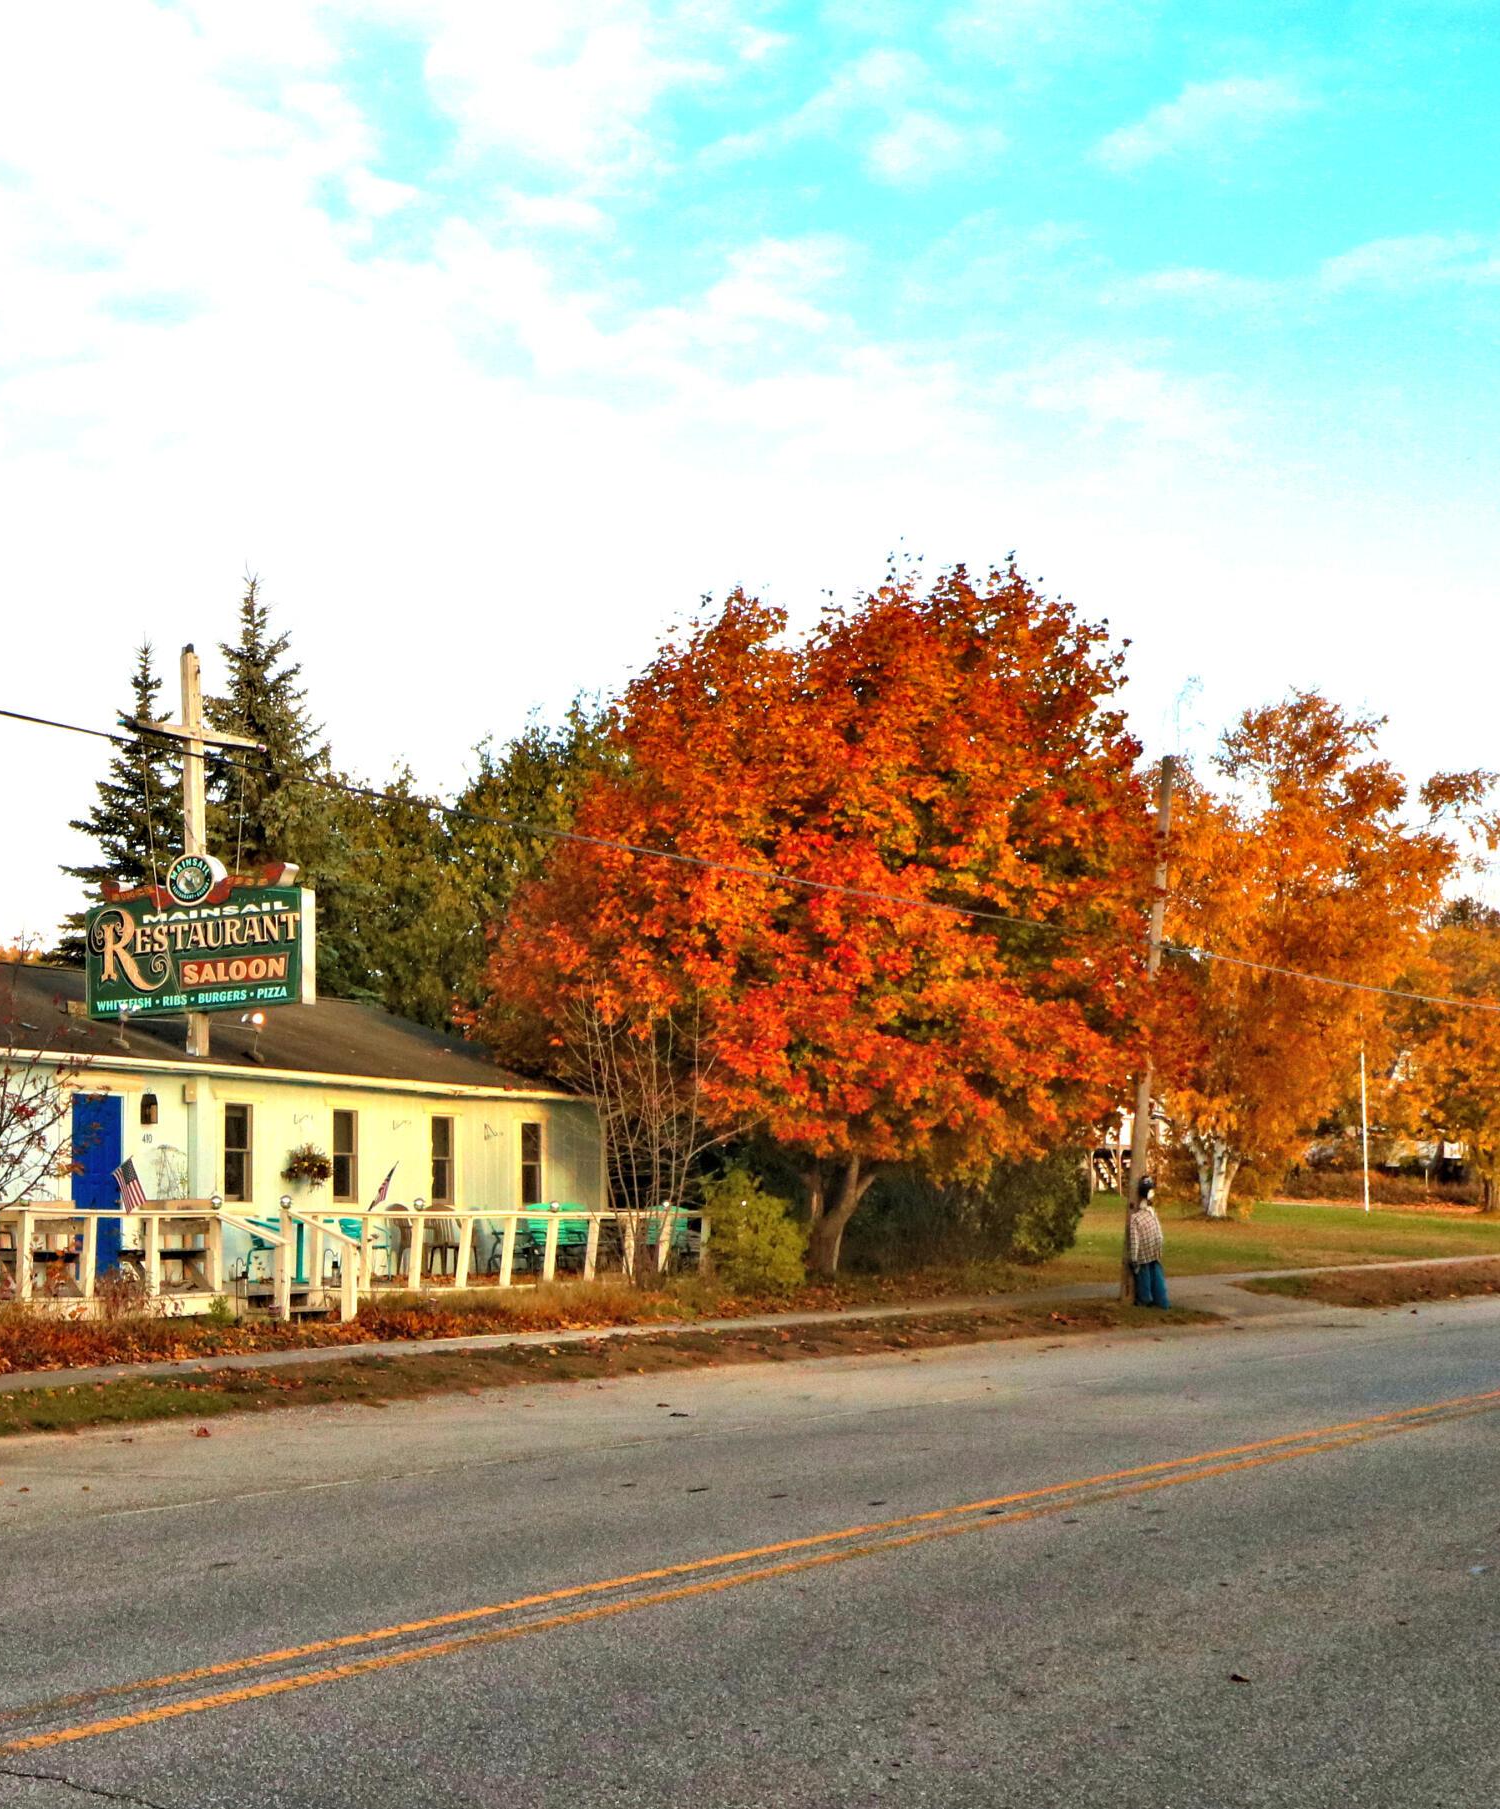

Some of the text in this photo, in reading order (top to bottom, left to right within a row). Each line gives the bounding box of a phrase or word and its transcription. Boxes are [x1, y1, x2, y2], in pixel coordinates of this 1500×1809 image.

[171, 858, 210, 880] MAINSAIL
[143, 901, 289, 923] MAINSAIL
[183, 957, 285, 985] SALOON
[97, 986, 287, 1012] WHITEFISH RIBS BURGERS PIZZA
